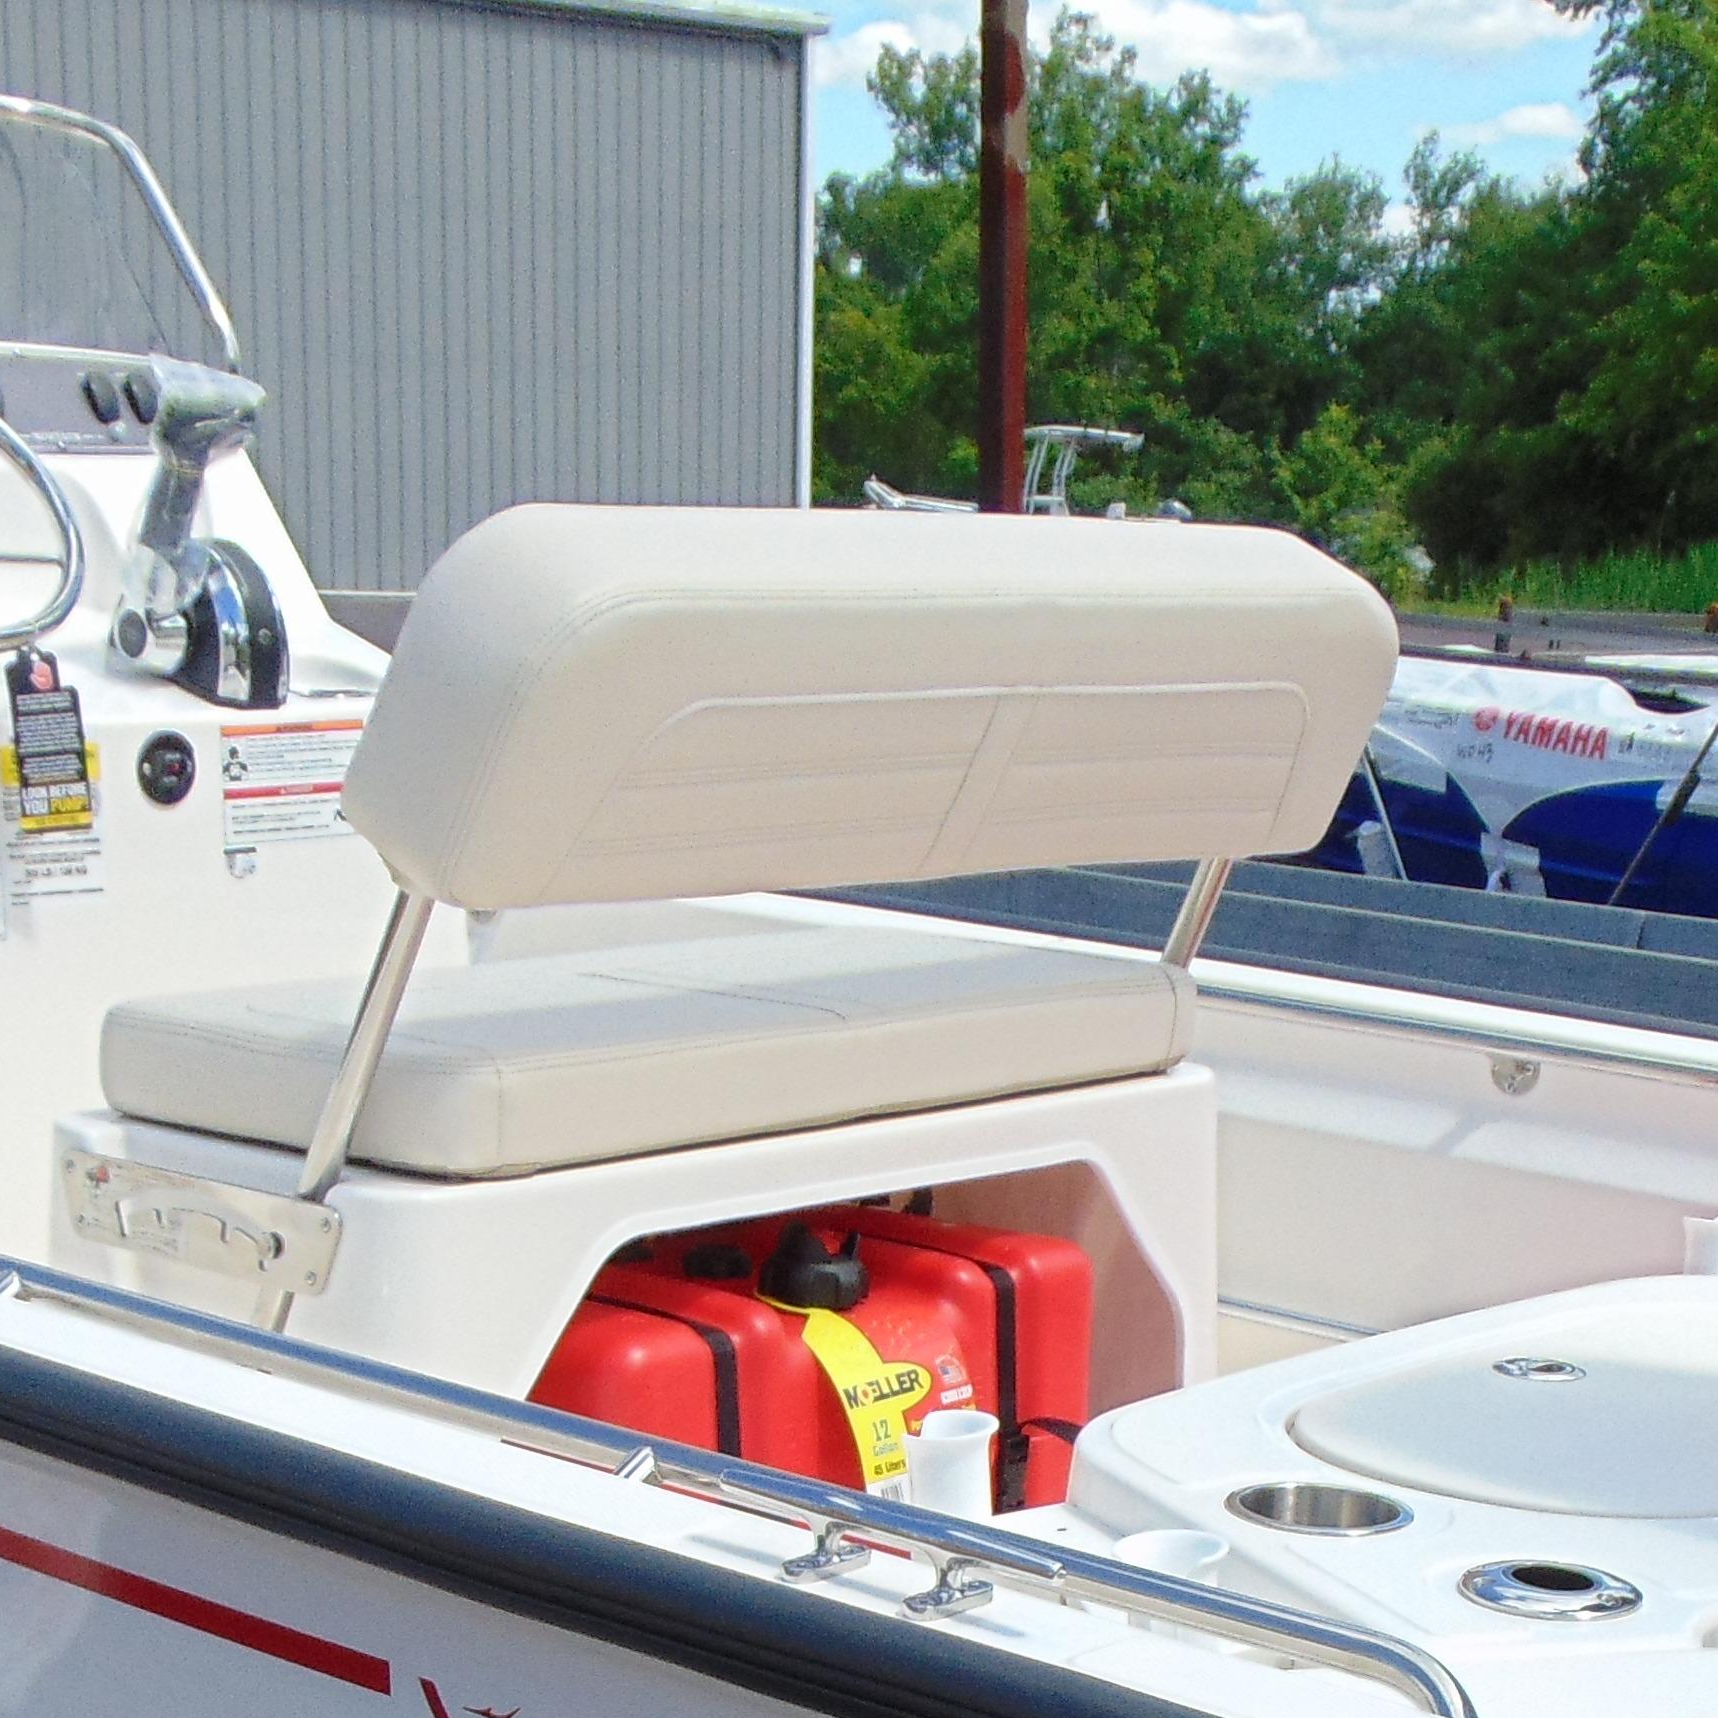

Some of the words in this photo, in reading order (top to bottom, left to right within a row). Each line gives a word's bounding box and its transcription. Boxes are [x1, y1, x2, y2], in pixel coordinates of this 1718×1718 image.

[1503, 711, 1611, 761] YAMAHA
[842, 1368, 925, 1410] MOELLER
[872, 1418, 892, 1442] 12
